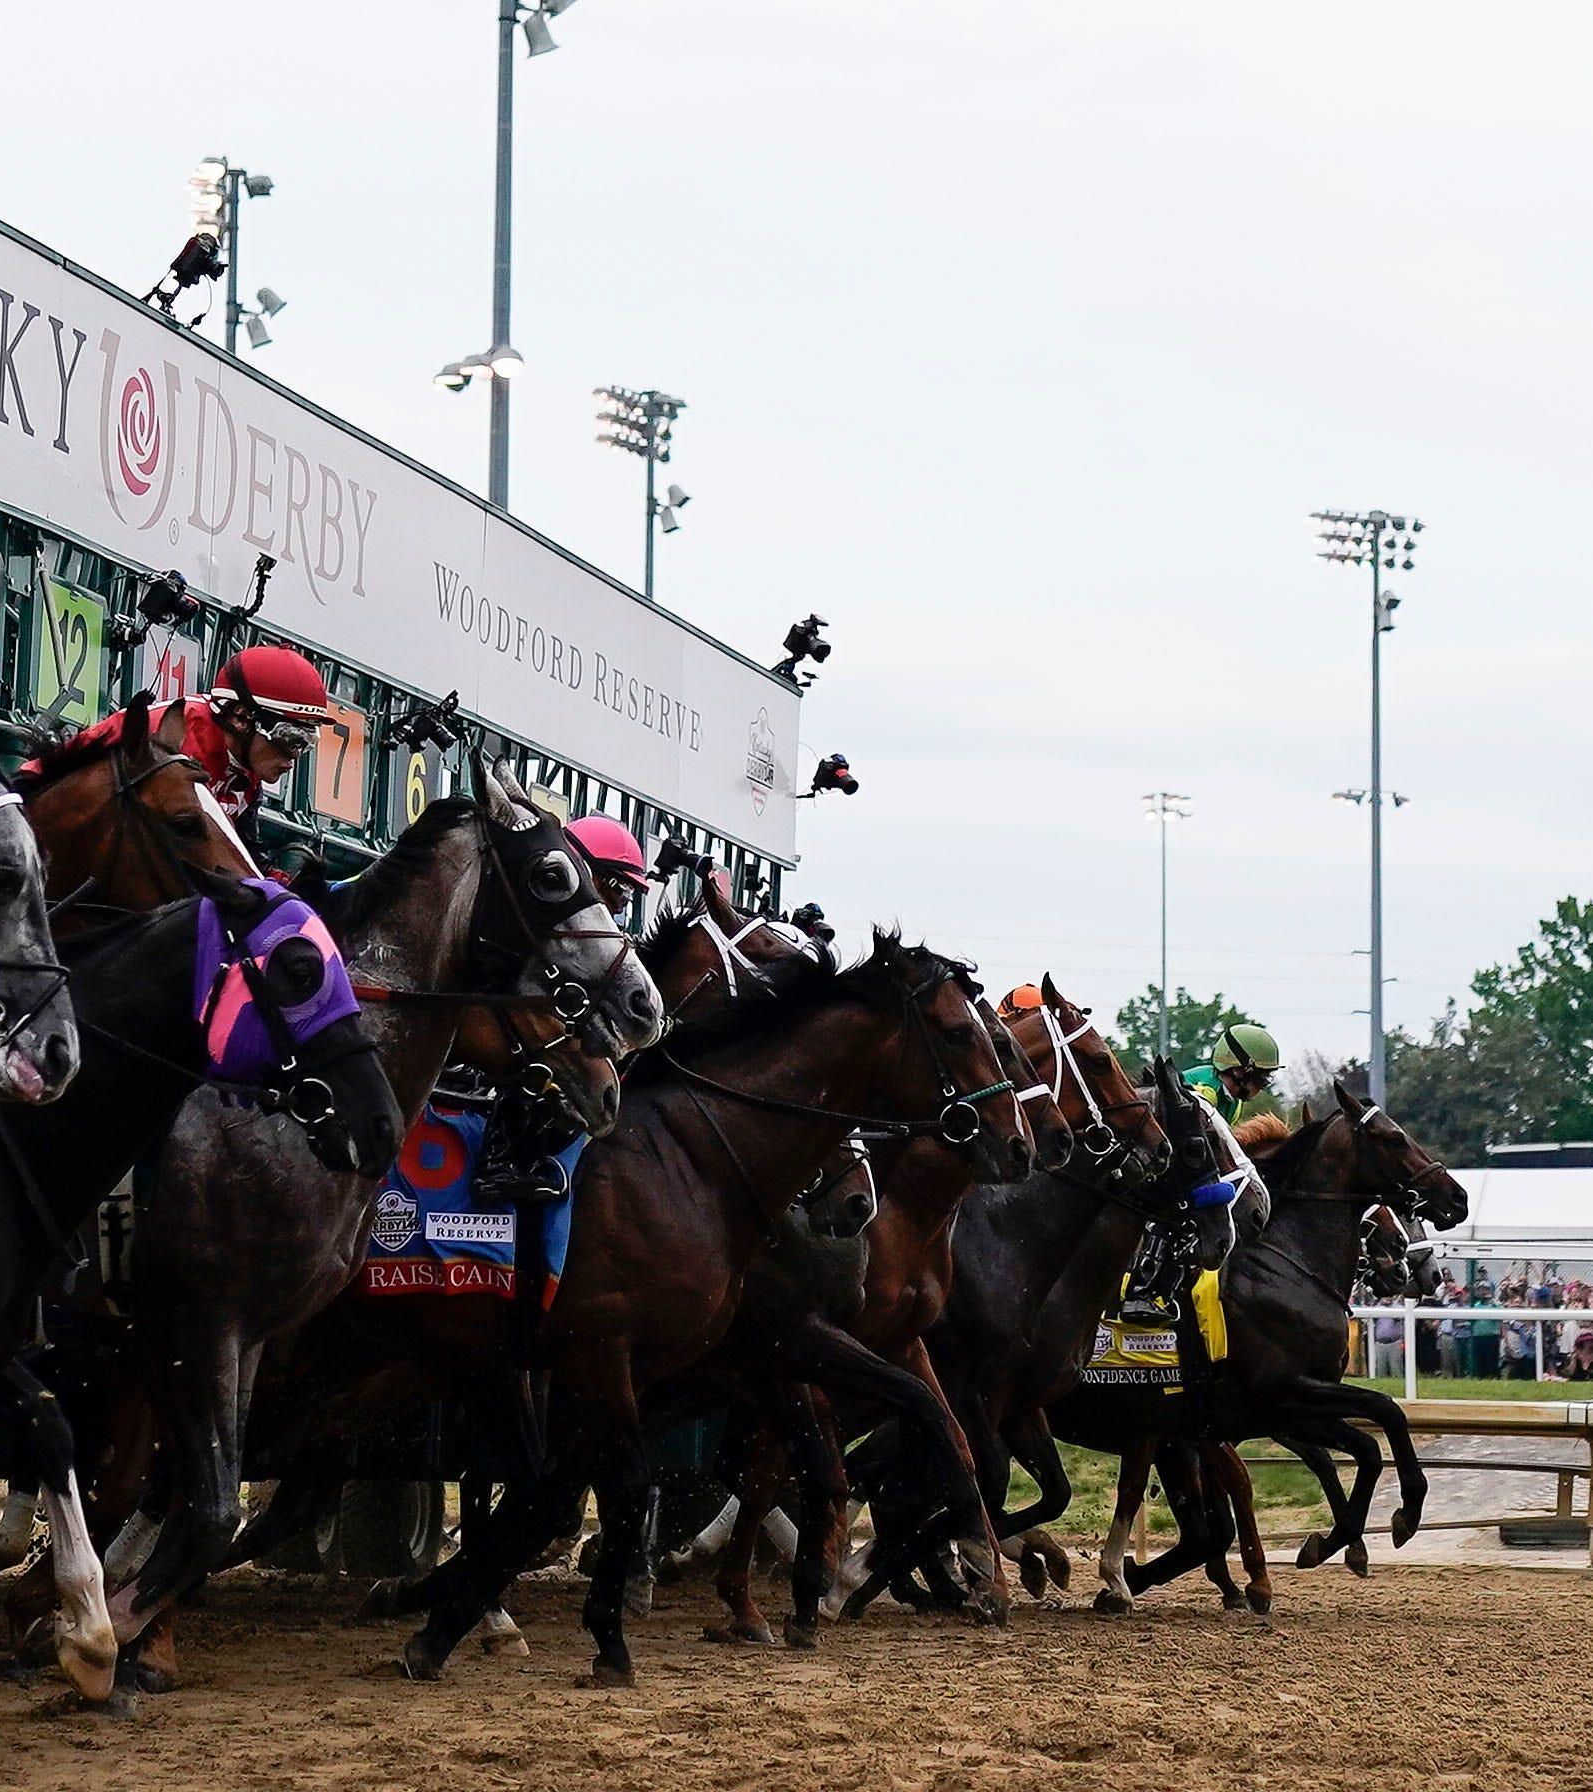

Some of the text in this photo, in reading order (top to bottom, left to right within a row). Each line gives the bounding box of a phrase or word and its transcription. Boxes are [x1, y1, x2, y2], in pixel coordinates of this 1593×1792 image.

[187, 377, 378, 606] DERBY
[58, 608, 88, 706] 12
[433, 561, 702, 753] WOODFORD RESERVE
[332, 722, 350, 800] 7
[406, 752, 427, 825] 6
[429, 1214, 510, 1226] WOODFORD
[436, 1227, 504, 1239] RESERVE
[450, 1265, 514, 1291] CAIN
[1150, 1369, 1182, 1383] GAME
